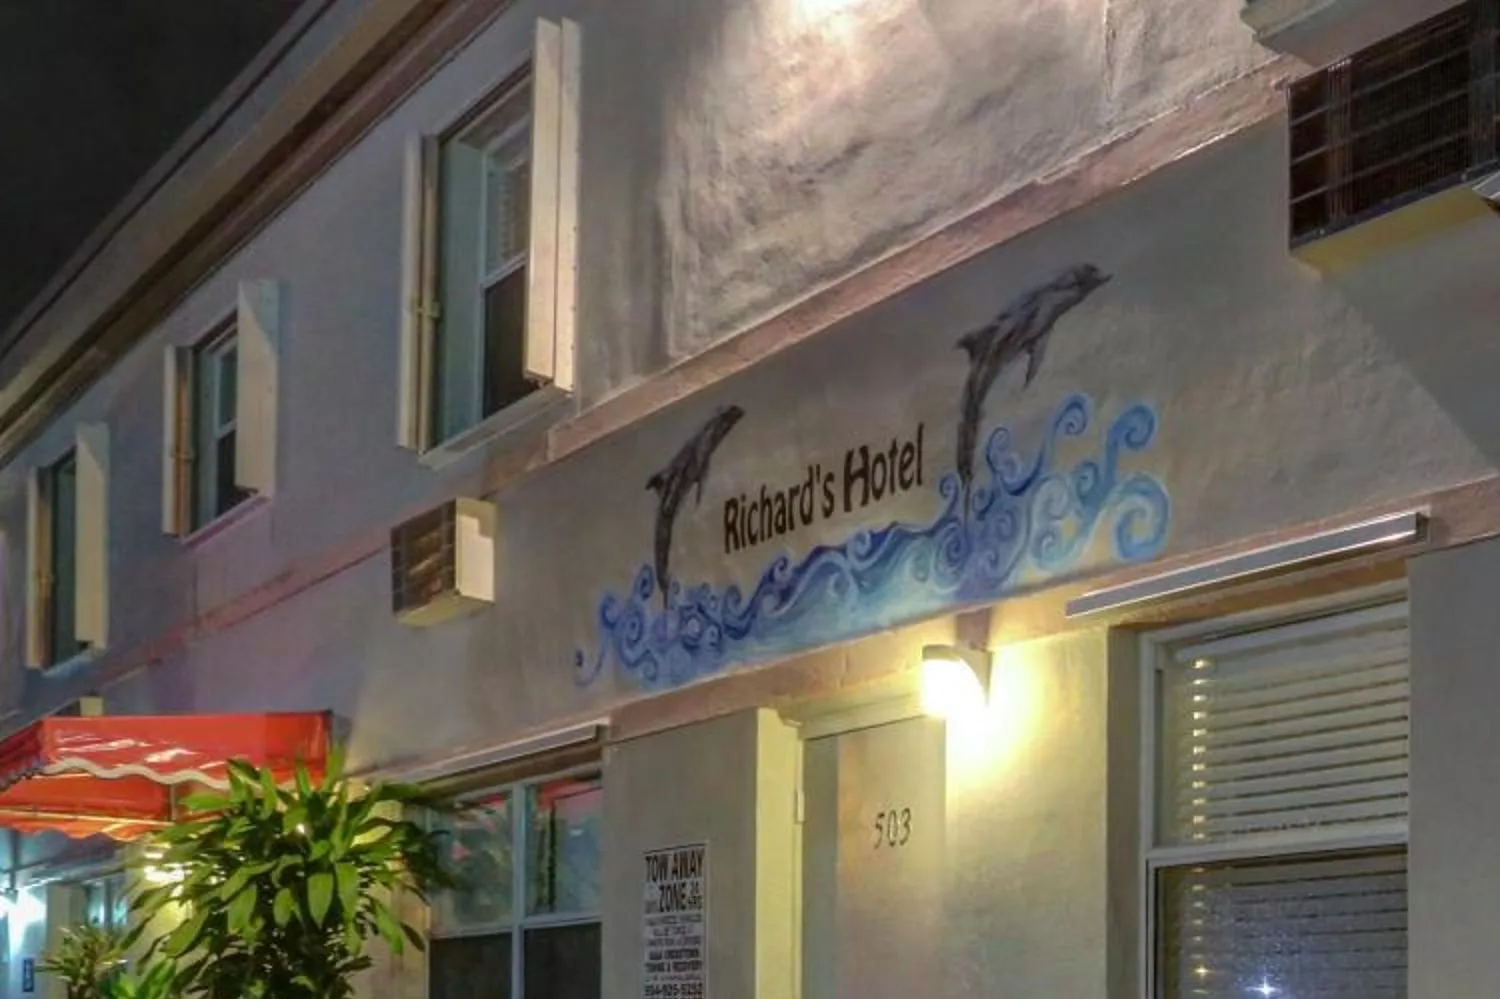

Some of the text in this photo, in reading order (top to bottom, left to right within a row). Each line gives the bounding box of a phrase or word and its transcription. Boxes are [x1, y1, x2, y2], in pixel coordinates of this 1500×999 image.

[724, 421, 925, 553] Richard's Hotel
[873, 807, 911, 850] 503
[645, 848, 704, 882] TOW AWAY
[659, 882, 687, 912] ZONE
